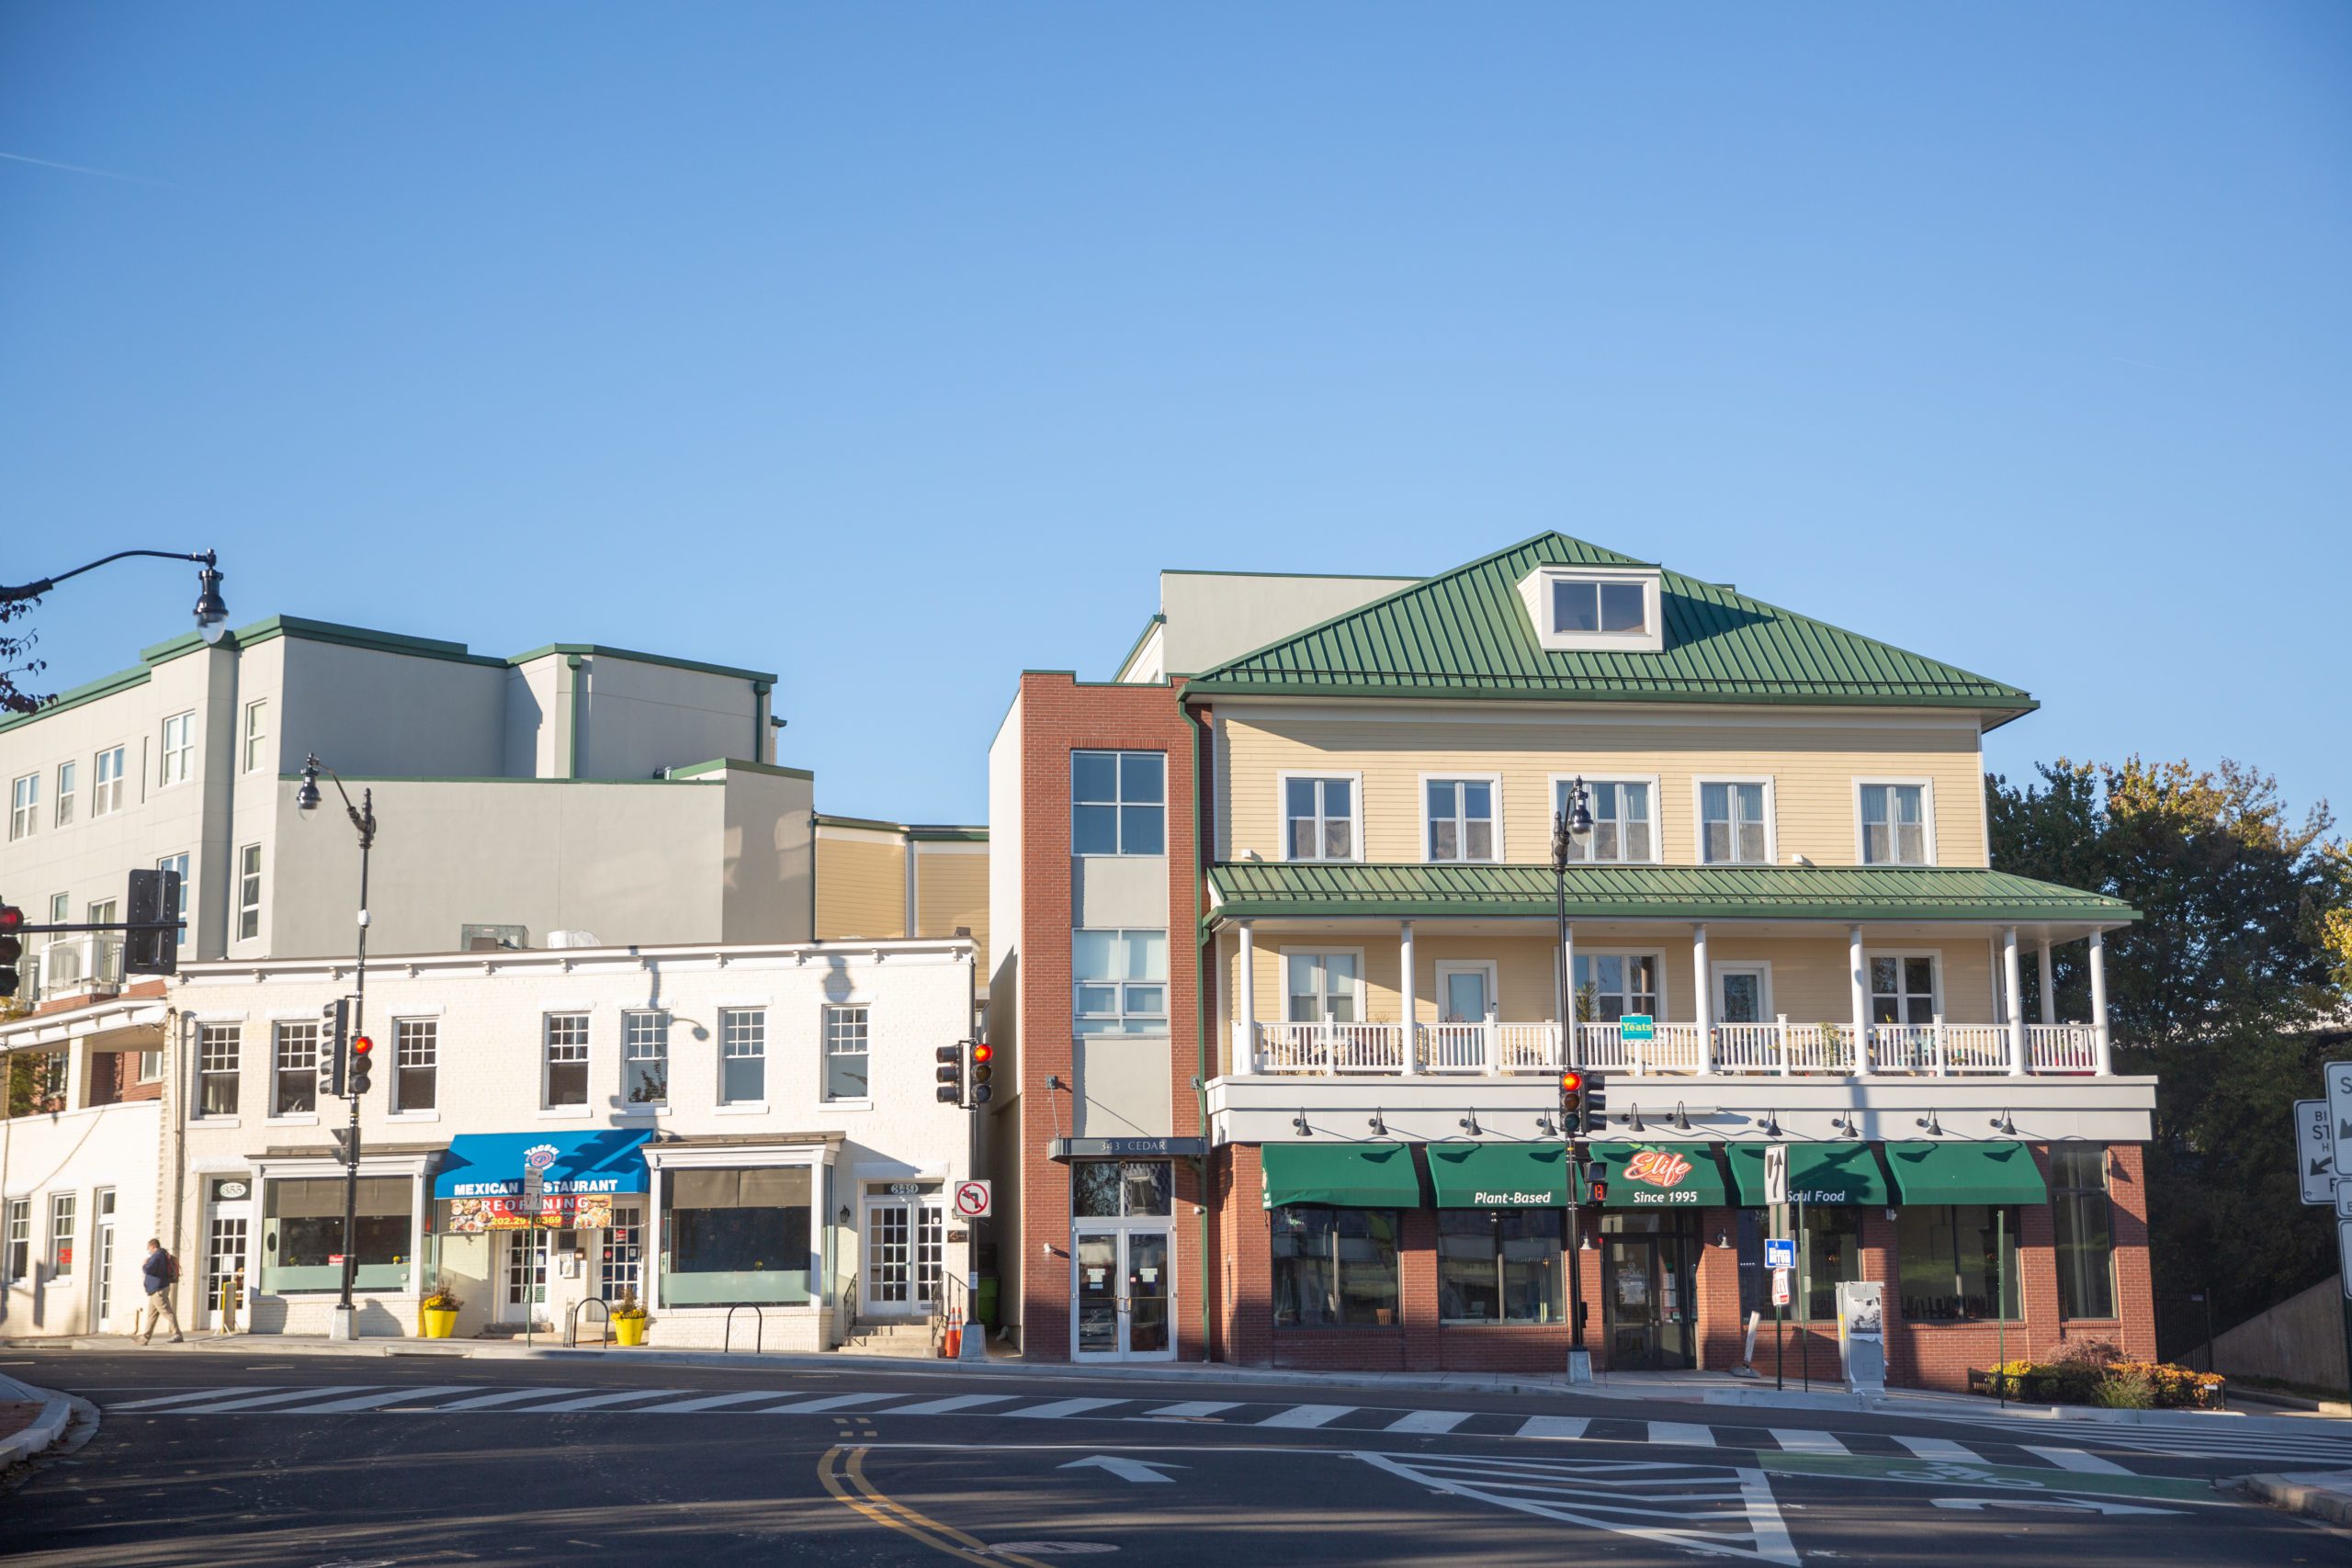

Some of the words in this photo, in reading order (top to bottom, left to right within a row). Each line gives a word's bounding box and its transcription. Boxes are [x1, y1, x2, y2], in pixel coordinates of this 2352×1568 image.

[1623, 1021, 1652, 1032] Yeats
[1102, 1141, 1120, 1151] 343
[1127, 1141, 1166, 1151] CEDAR
[1623, 1151, 1692, 1187] Elife
[454, 1182, 518, 1195] MEXICAN
[542, 1179, 618, 1193] STAURANT
[1475, 1191, 1551, 1204] Plant-Based
[1634, 1191, 1665, 1203] Since
[1668, 1191, 1698, 1203] 1995
[1788, 1190, 1811, 1202] Soul
[1815, 1190, 1846, 1202] Food
[481, 1196, 589, 1212] REONING
